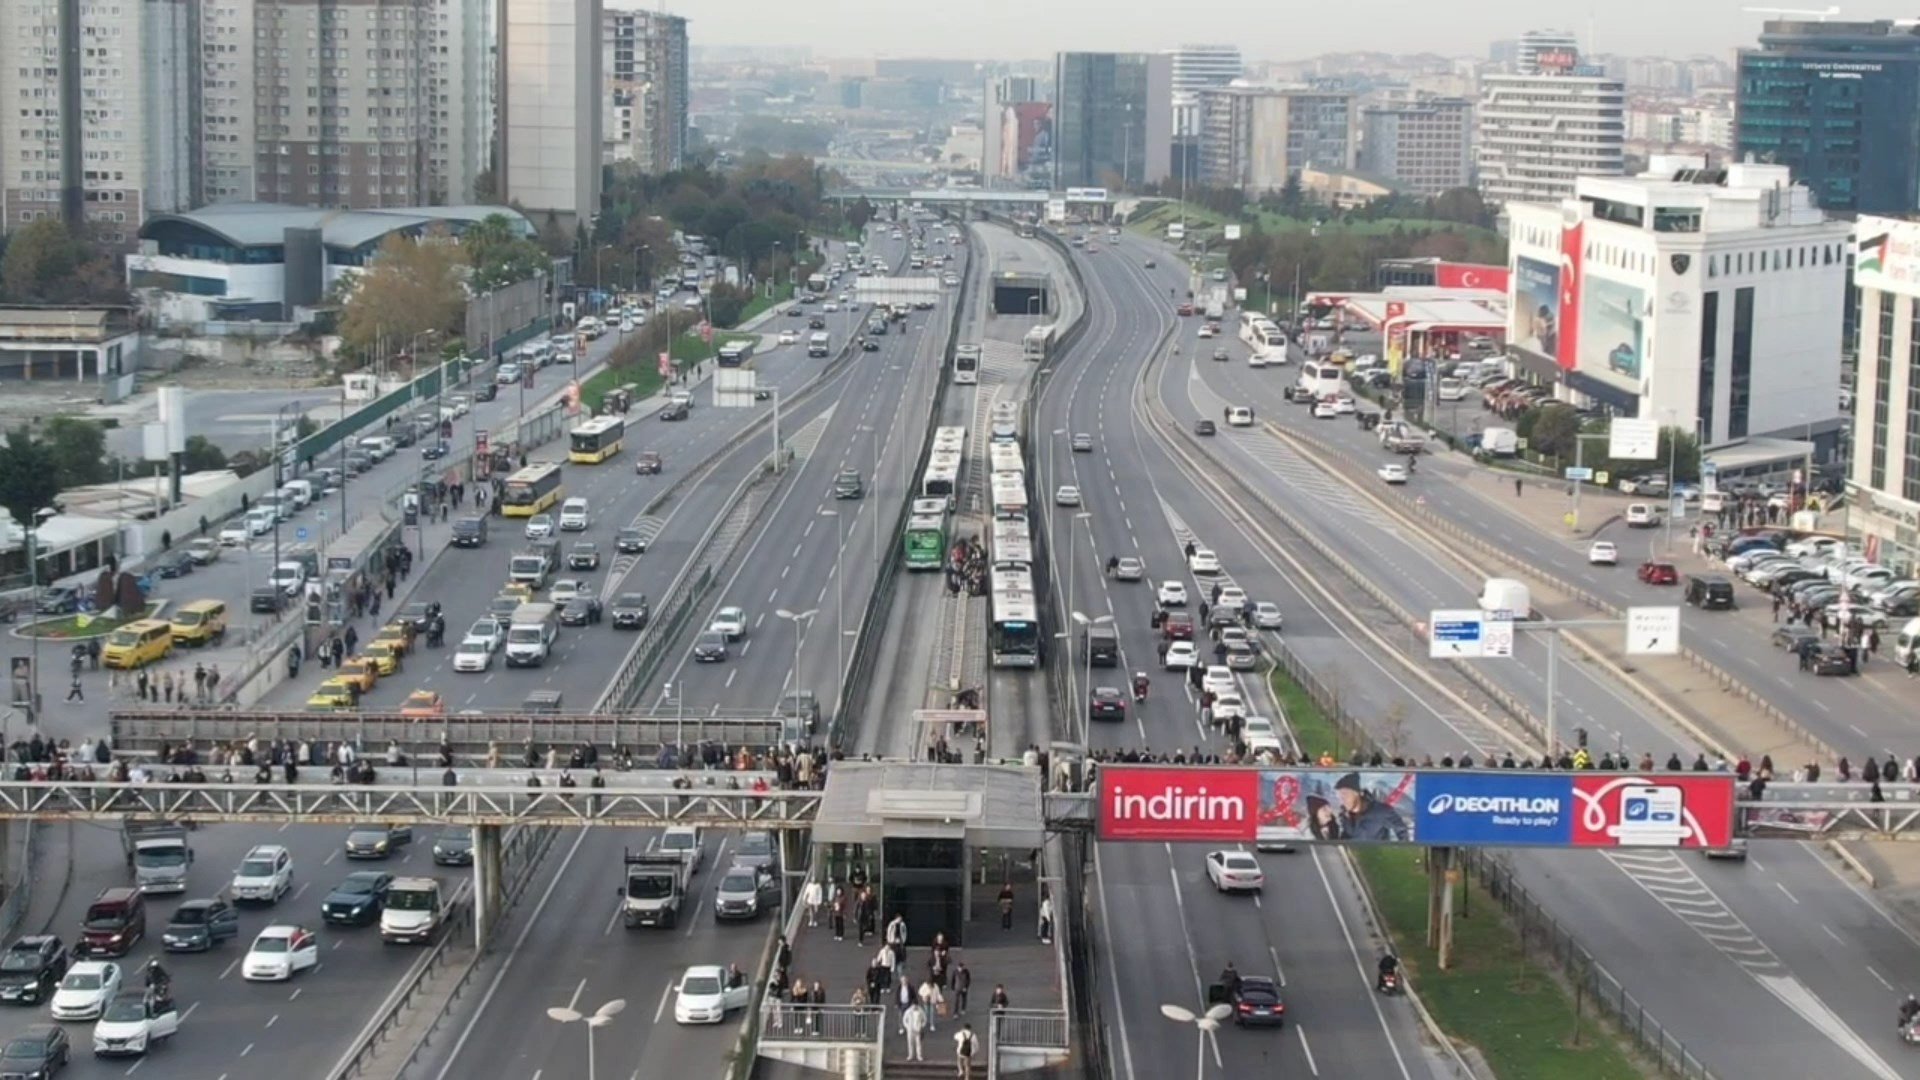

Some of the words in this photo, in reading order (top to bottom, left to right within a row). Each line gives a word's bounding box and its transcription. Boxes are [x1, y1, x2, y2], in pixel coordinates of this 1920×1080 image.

[1114, 786, 1243, 820] indirim
[1455, 797, 1559, 813] DECATHLON
[1492, 815, 1521, 826] Ready
[1523, 816, 1532, 825] to
[1533, 816, 1558, 827] play?
